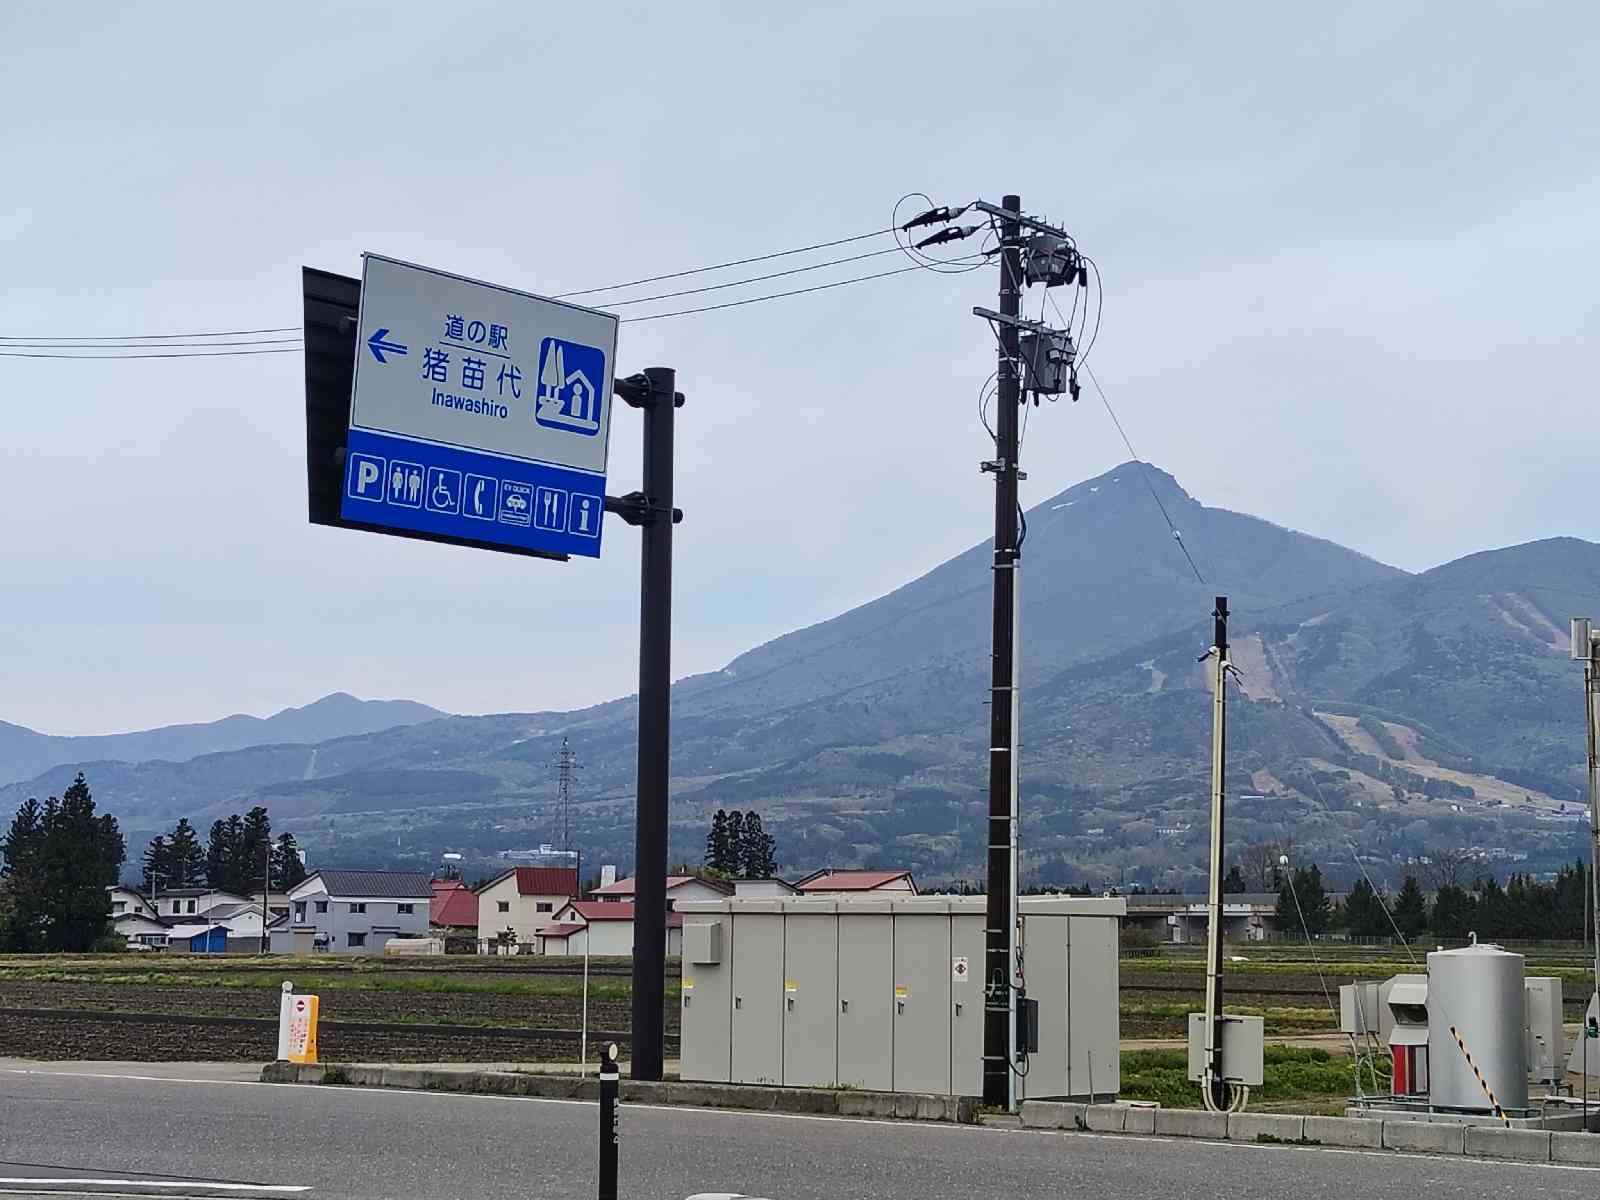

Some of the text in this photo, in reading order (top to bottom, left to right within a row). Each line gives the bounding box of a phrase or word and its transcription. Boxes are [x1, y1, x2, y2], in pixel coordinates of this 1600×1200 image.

[445, 314, 508, 351] 道の駅
[422, 347, 522, 399] 猪苗代
[431, 387, 508, 419] Inawashiro
[357, 461, 379, 493] P
